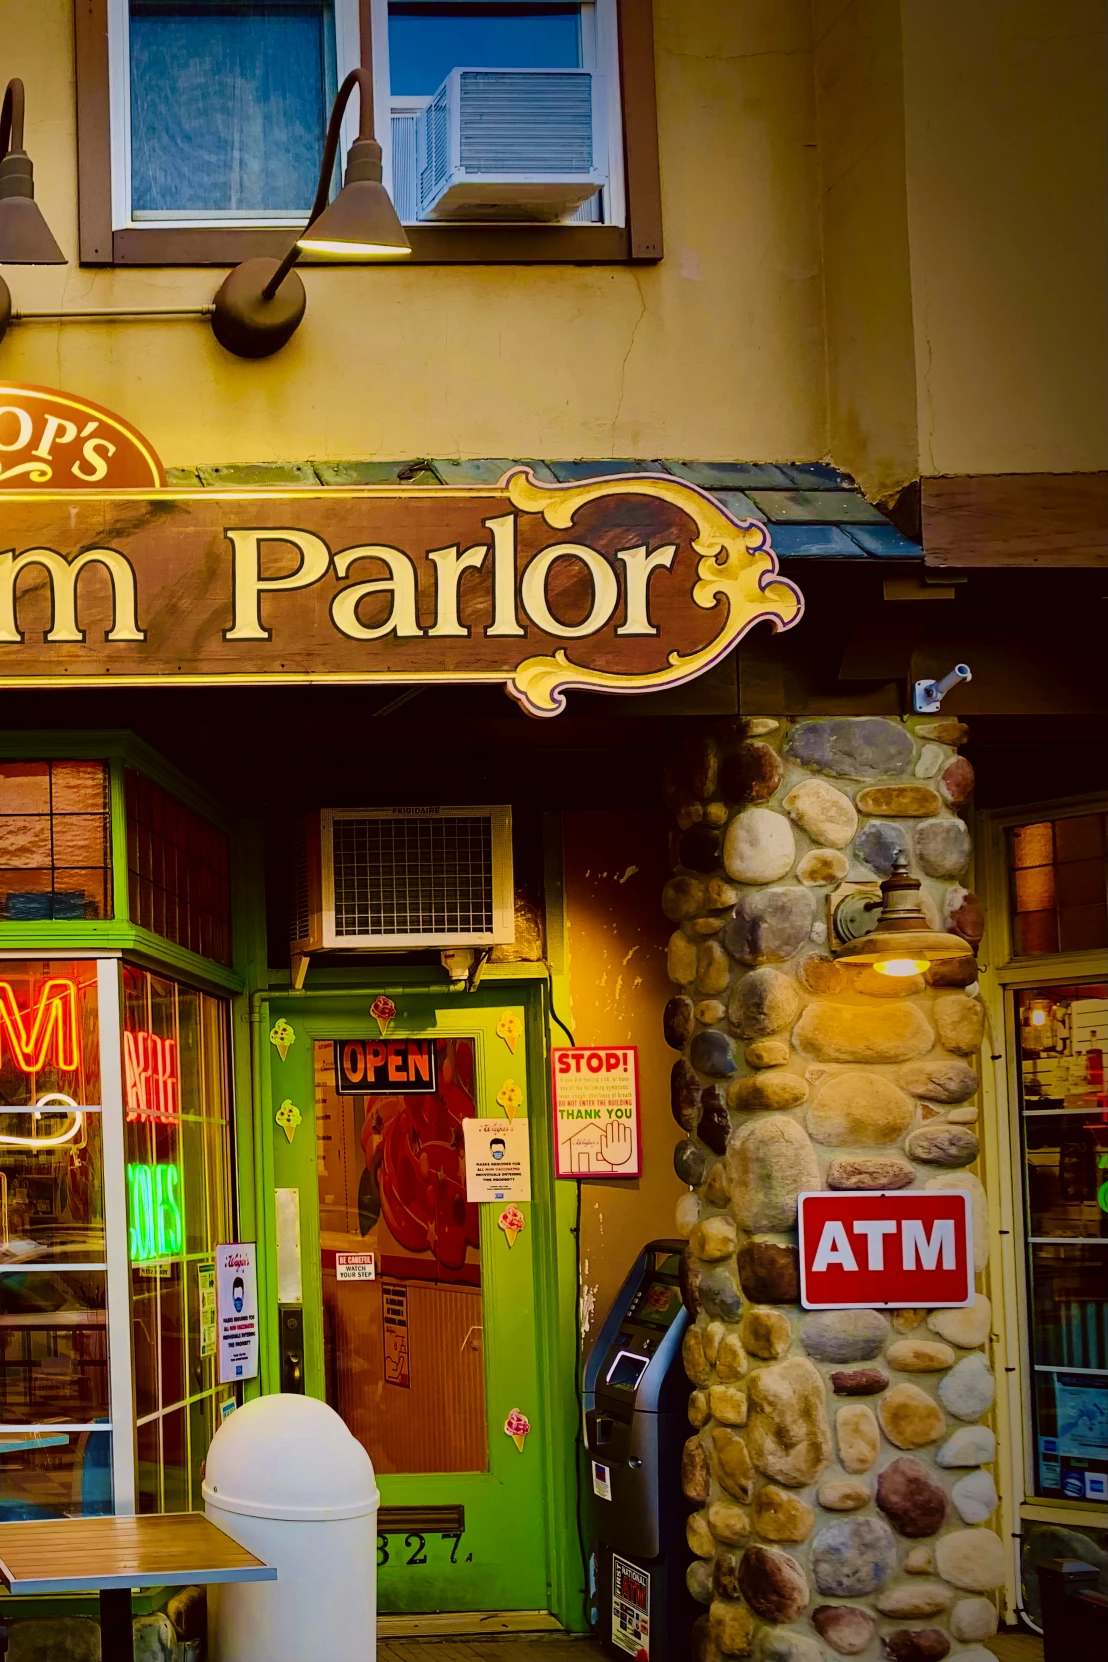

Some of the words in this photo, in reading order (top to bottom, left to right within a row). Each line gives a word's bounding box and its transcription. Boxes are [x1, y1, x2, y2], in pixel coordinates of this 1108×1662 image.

[223, 511, 680, 642] Parlor
[392, 806, 441, 814] FRIGIDAIRE
[342, 1039, 430, 1083] OPEN
[557, 1052, 628, 1074] STOP!
[559, 1109, 601, 1119] THANK
[607, 1108, 632, 1119] YOU
[811, 1219, 957, 1272] ATM
[340, 1256, 347, 1264] BE
[348, 1255, 371, 1264] CAREFUL
[622, 1566, 646, 1587] NATIONAL
